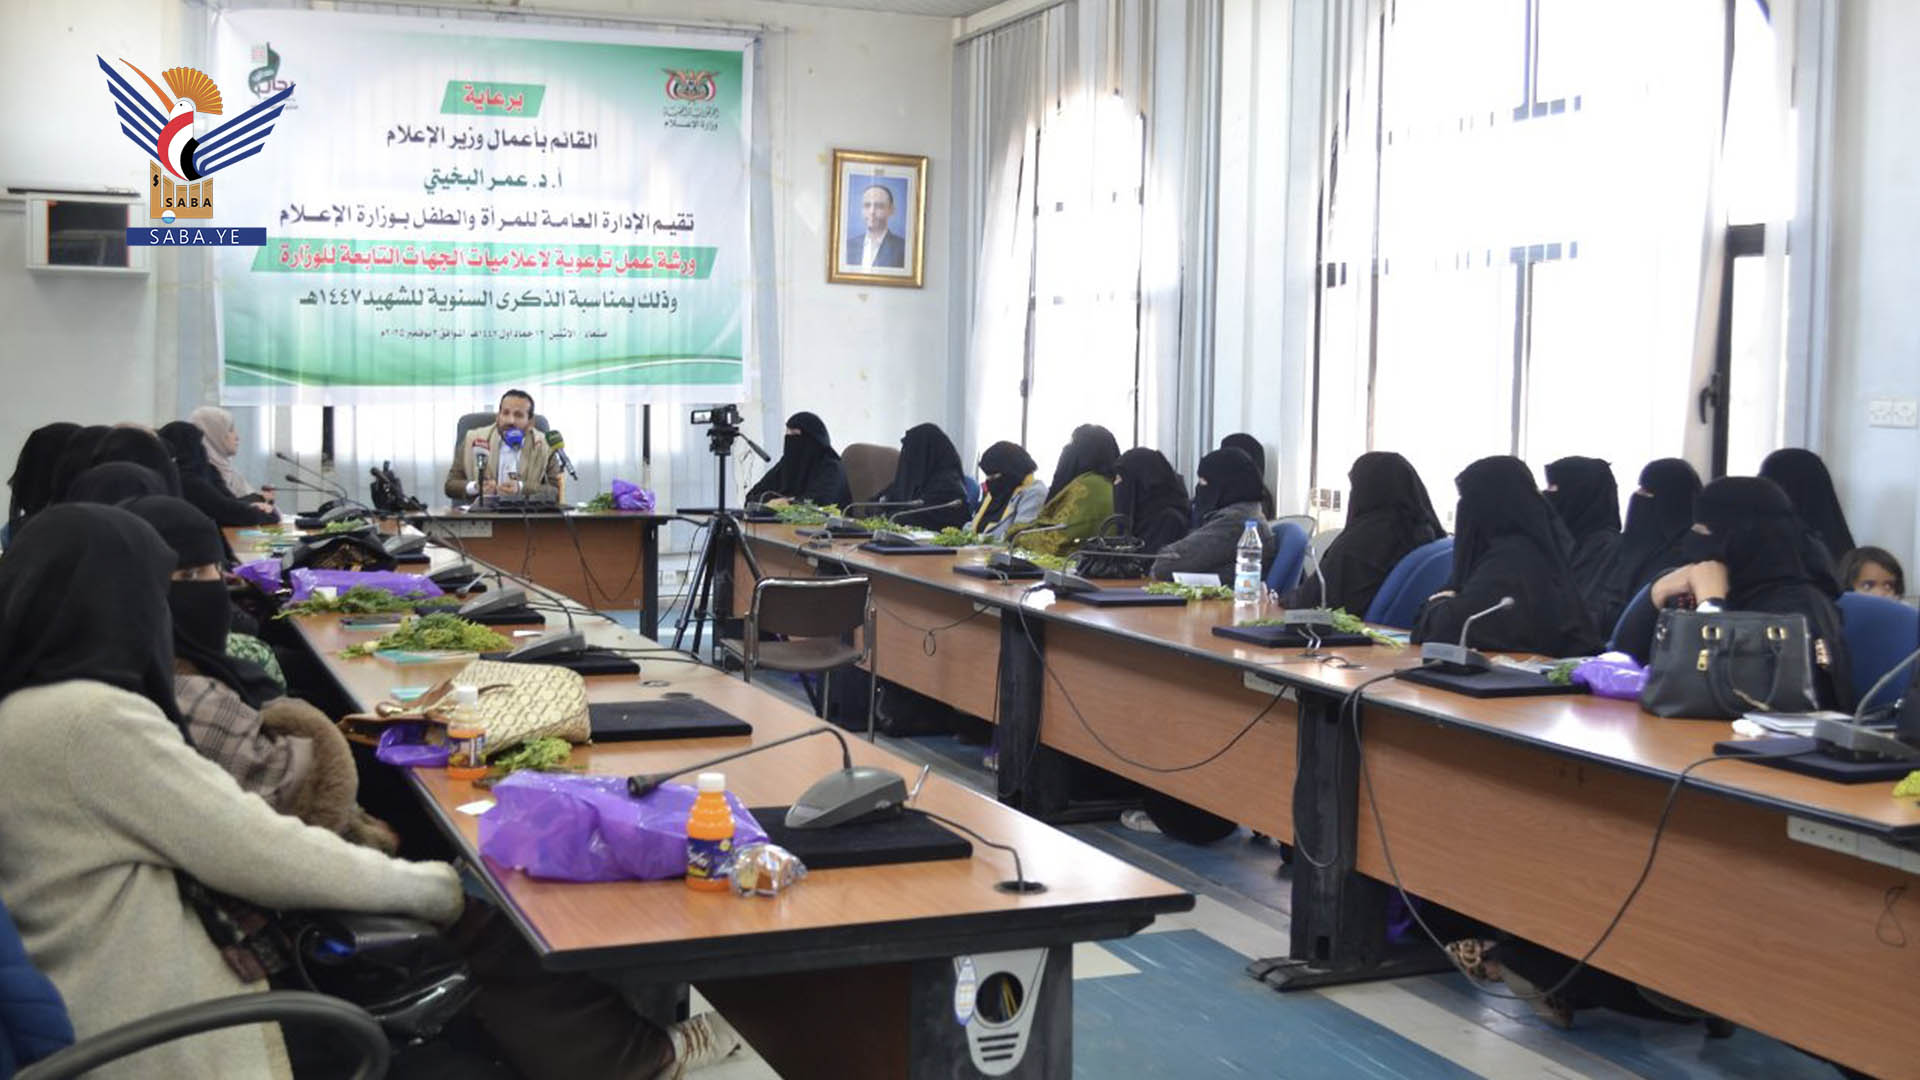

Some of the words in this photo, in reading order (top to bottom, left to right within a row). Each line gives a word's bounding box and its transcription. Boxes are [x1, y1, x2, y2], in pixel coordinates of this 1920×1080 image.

[463, 84, 524, 111] برعاية
[387, 125, 445, 148] الإعلام
[450, 127, 483, 150] وزير
[488, 126, 547, 152] بأعمال
[551, 131, 598, 151] القائم
[424, 166, 484, 194] البخيتي
[487, 173, 527, 190] عمر
[280, 203, 351, 228] الإعلام
[356, 205, 410, 229] بوزارة
[413, 207, 475, 230] والطفل
[481, 207, 537, 231] للمرأة
[542, 210, 598, 230] العامة
[602, 211, 650, 234] الإدارة
[653, 213, 695, 235] تقيم
[280, 244, 336, 269] للوزارة
[340, 245, 399, 270] التابعة
[403, 246, 463, 271] الجهات
[555, 250, 612, 274] توعوية
[615, 251, 653, 274] عمل
[657, 250, 696, 275] ورشة
[363, 285, 423, 312] للشهيد
[427, 287, 493, 312] السنوية
[496, 289, 565, 312] الذكرى
[569, 289, 635, 313] بمناسبة
[639, 289, 678, 313] وذلك
